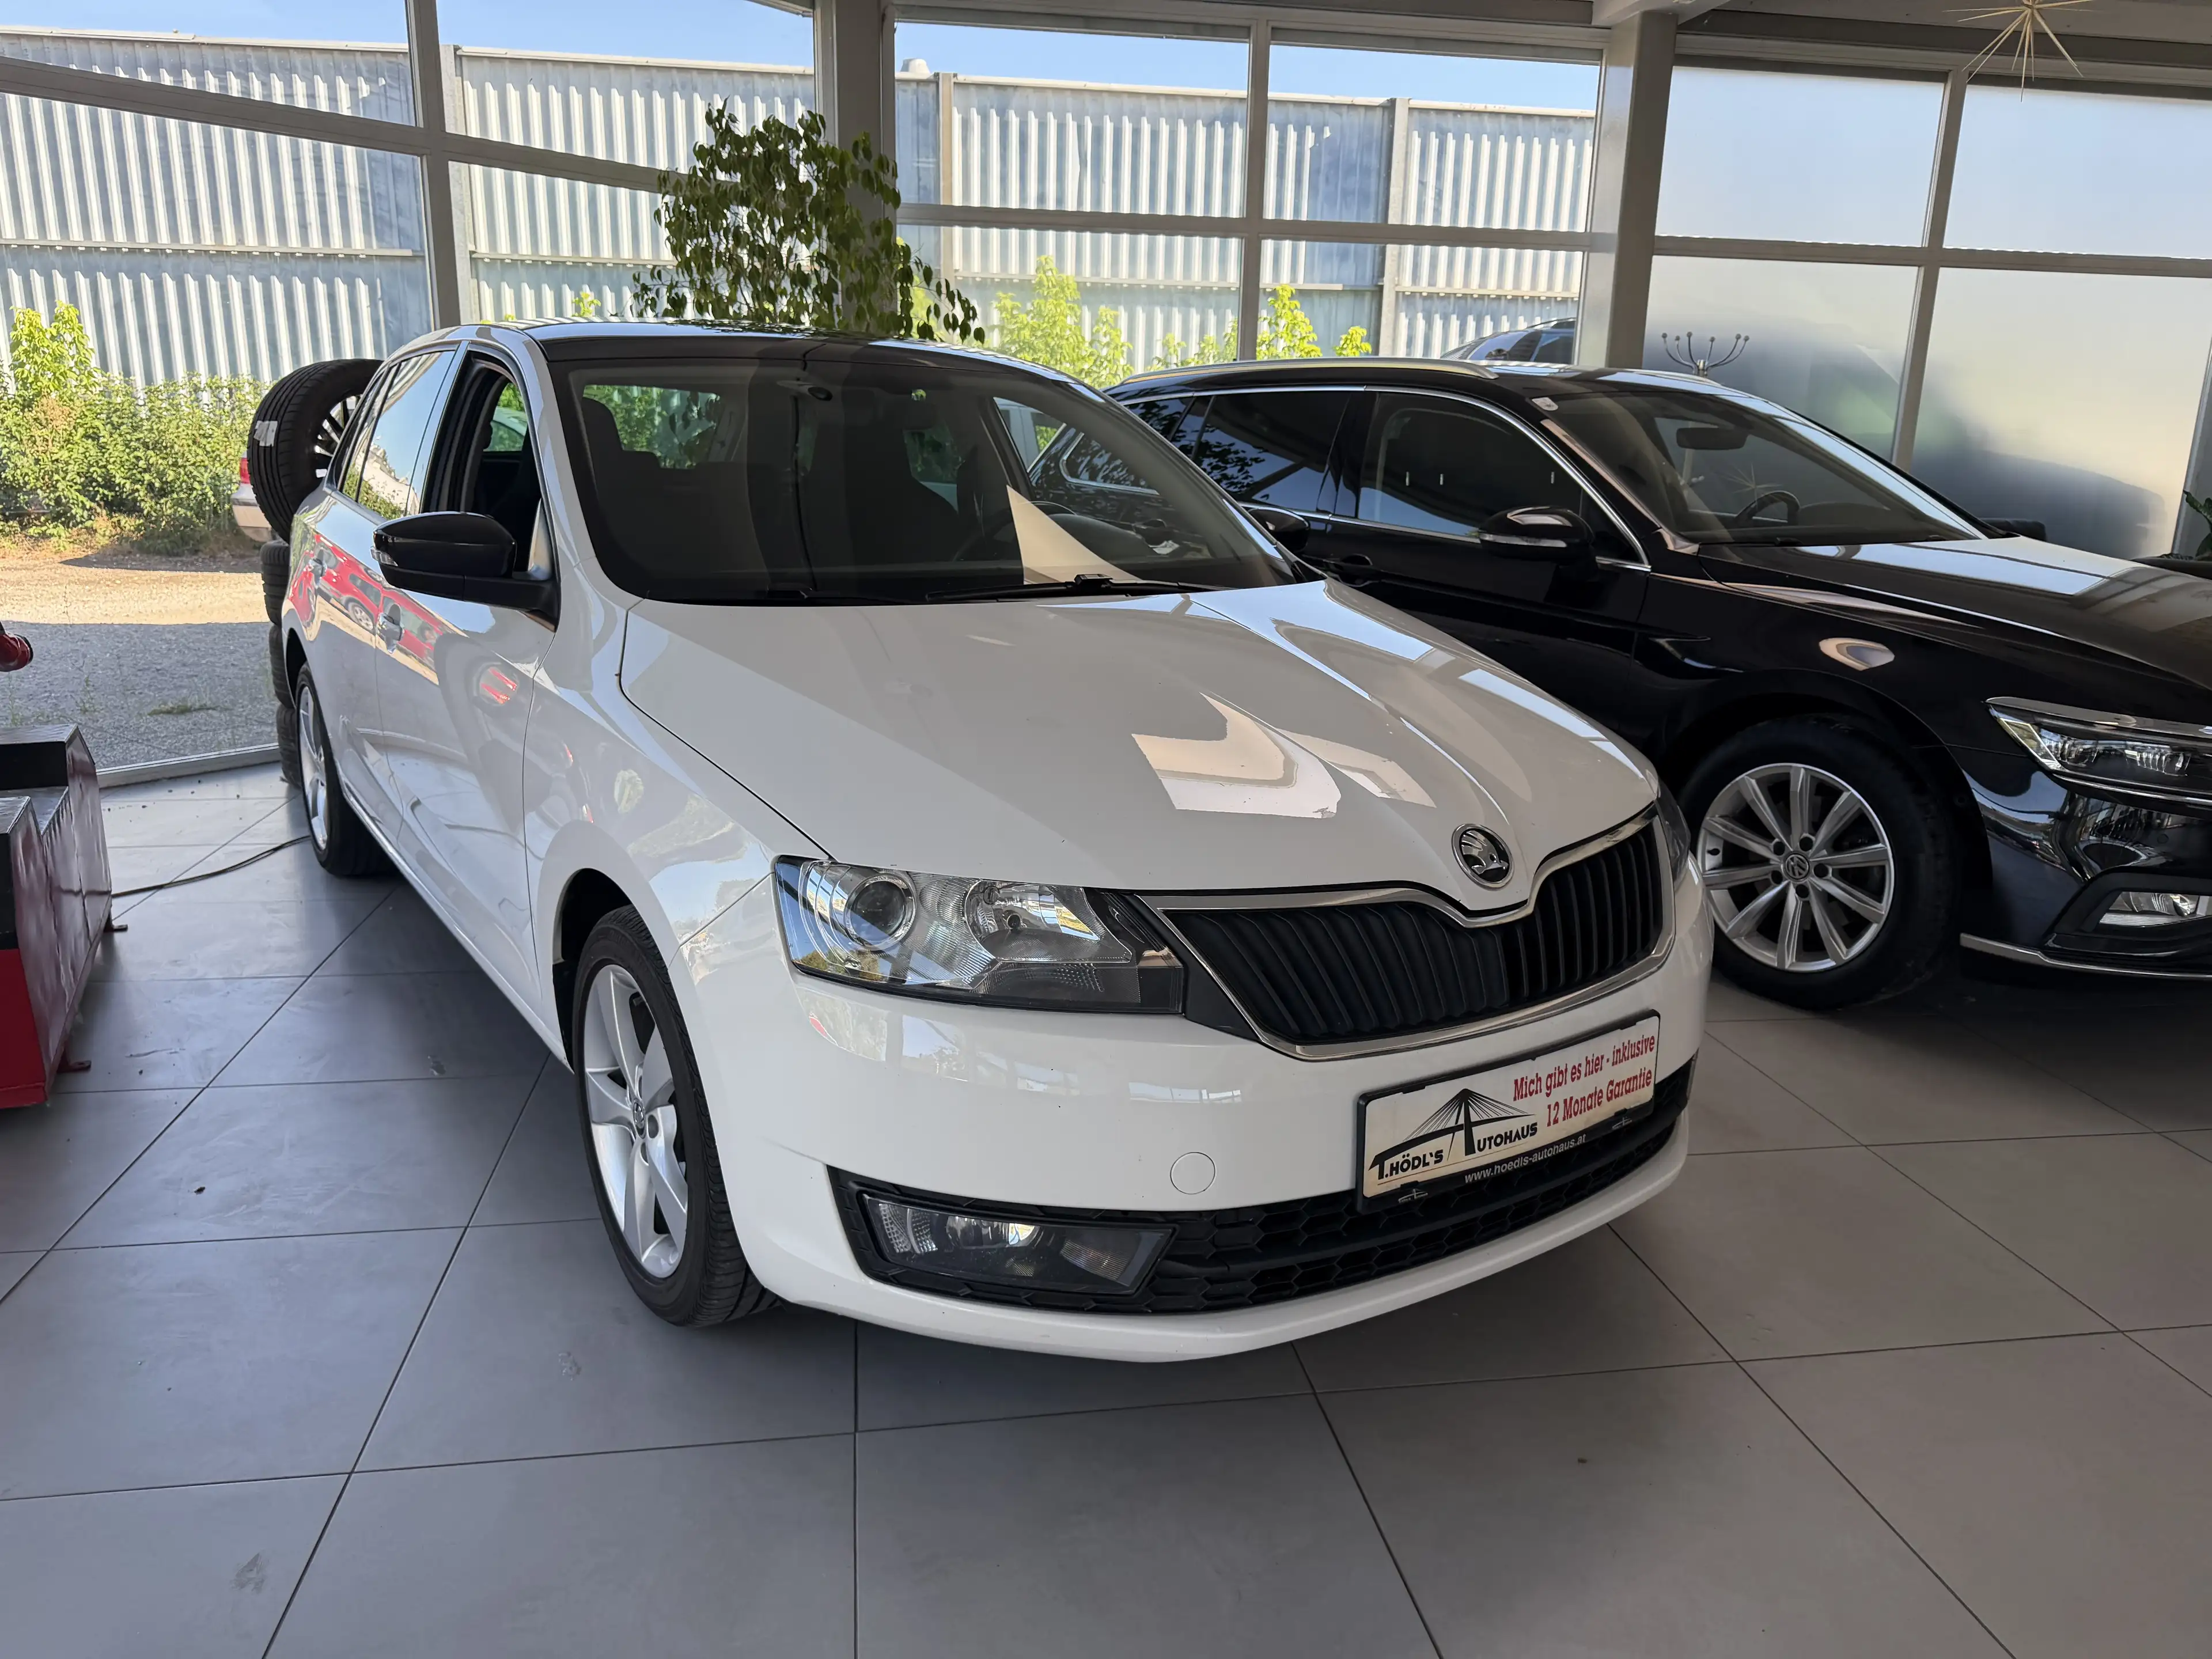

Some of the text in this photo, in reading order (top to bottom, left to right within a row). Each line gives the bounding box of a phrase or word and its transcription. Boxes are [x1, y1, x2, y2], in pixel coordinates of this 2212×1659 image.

[1513, 1073, 1542, 1101] Mich
[1546, 1063, 1568, 1097] gibt
[1571, 1063, 1582, 1082] es
[1584, 1054, 1604, 1077] hier
[1612, 1035, 1655, 1066] inklusive
[1547, 1067, 1652, 1127] 12 Monate Garantie
[1464, 1134, 1586, 1184] www.hoedls-autohaus.at
